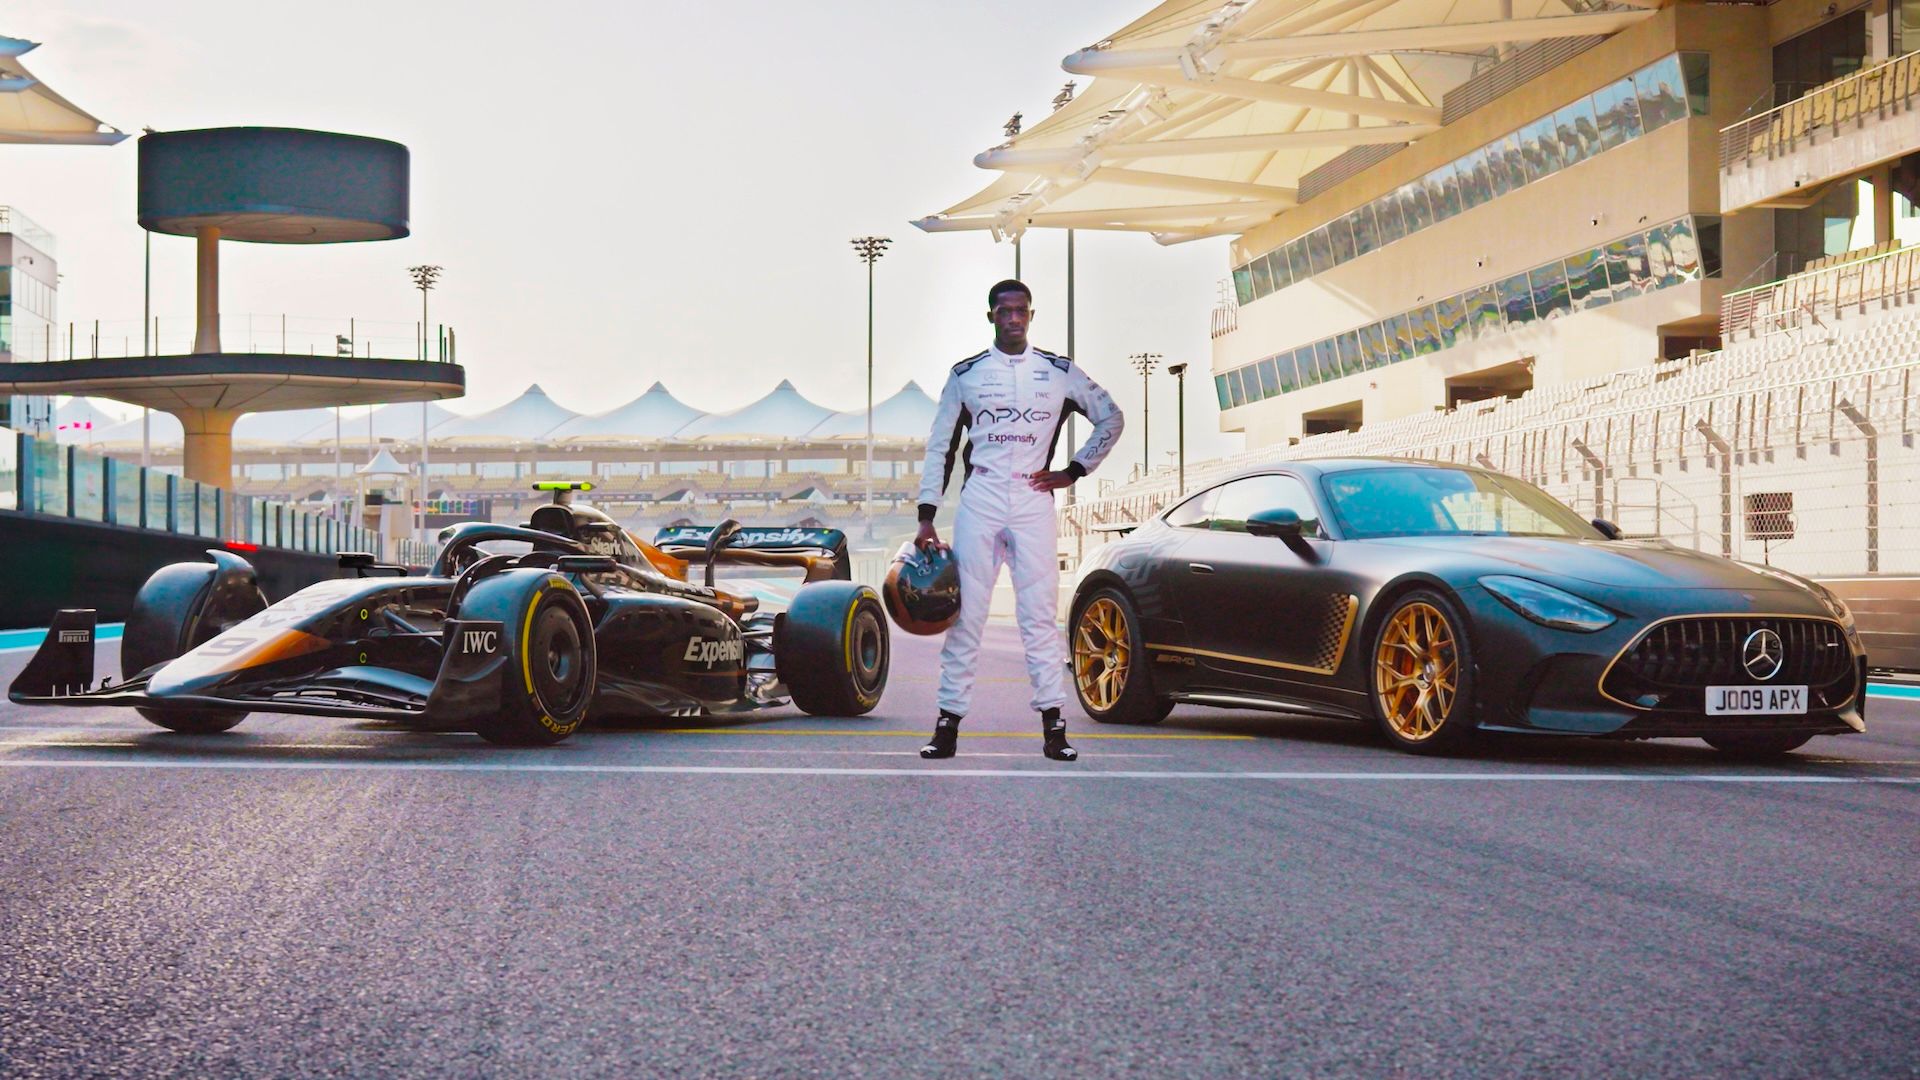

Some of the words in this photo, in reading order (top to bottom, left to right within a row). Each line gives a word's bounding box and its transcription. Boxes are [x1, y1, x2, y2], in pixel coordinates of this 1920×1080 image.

[987, 433, 1038, 446] Expensify
[676, 528, 815, 546] Exensify
[462, 630, 497, 654] IWC
[1769, 689, 1800, 710] APX
